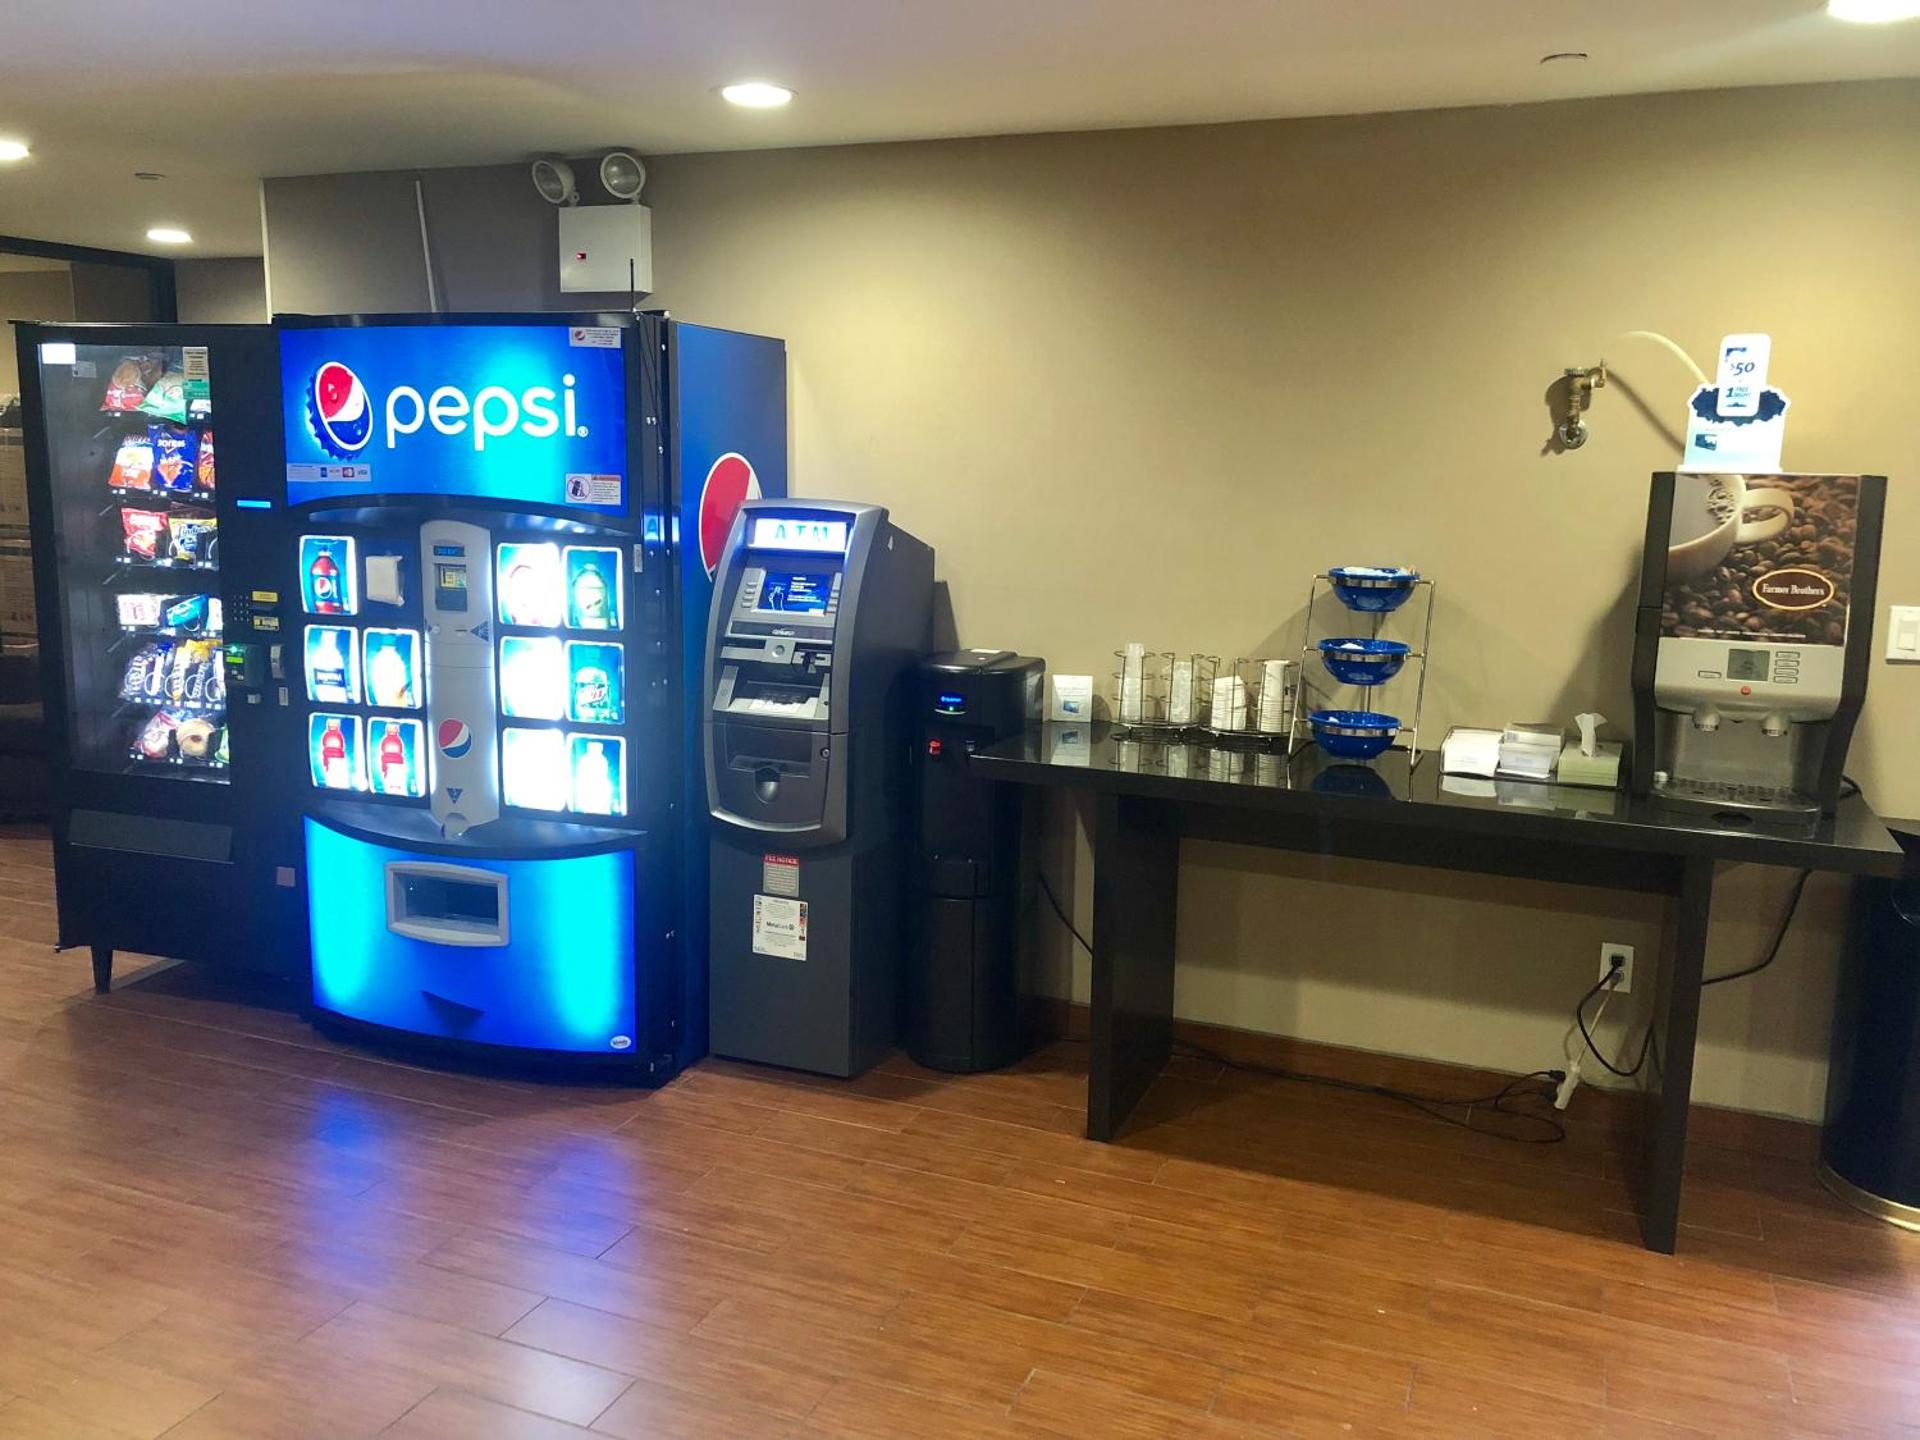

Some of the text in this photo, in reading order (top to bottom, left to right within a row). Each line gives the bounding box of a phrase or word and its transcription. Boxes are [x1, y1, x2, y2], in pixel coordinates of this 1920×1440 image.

[386, 373, 577, 451] pepsi
[1762, 583, 1825, 596] Farmer Brothers
